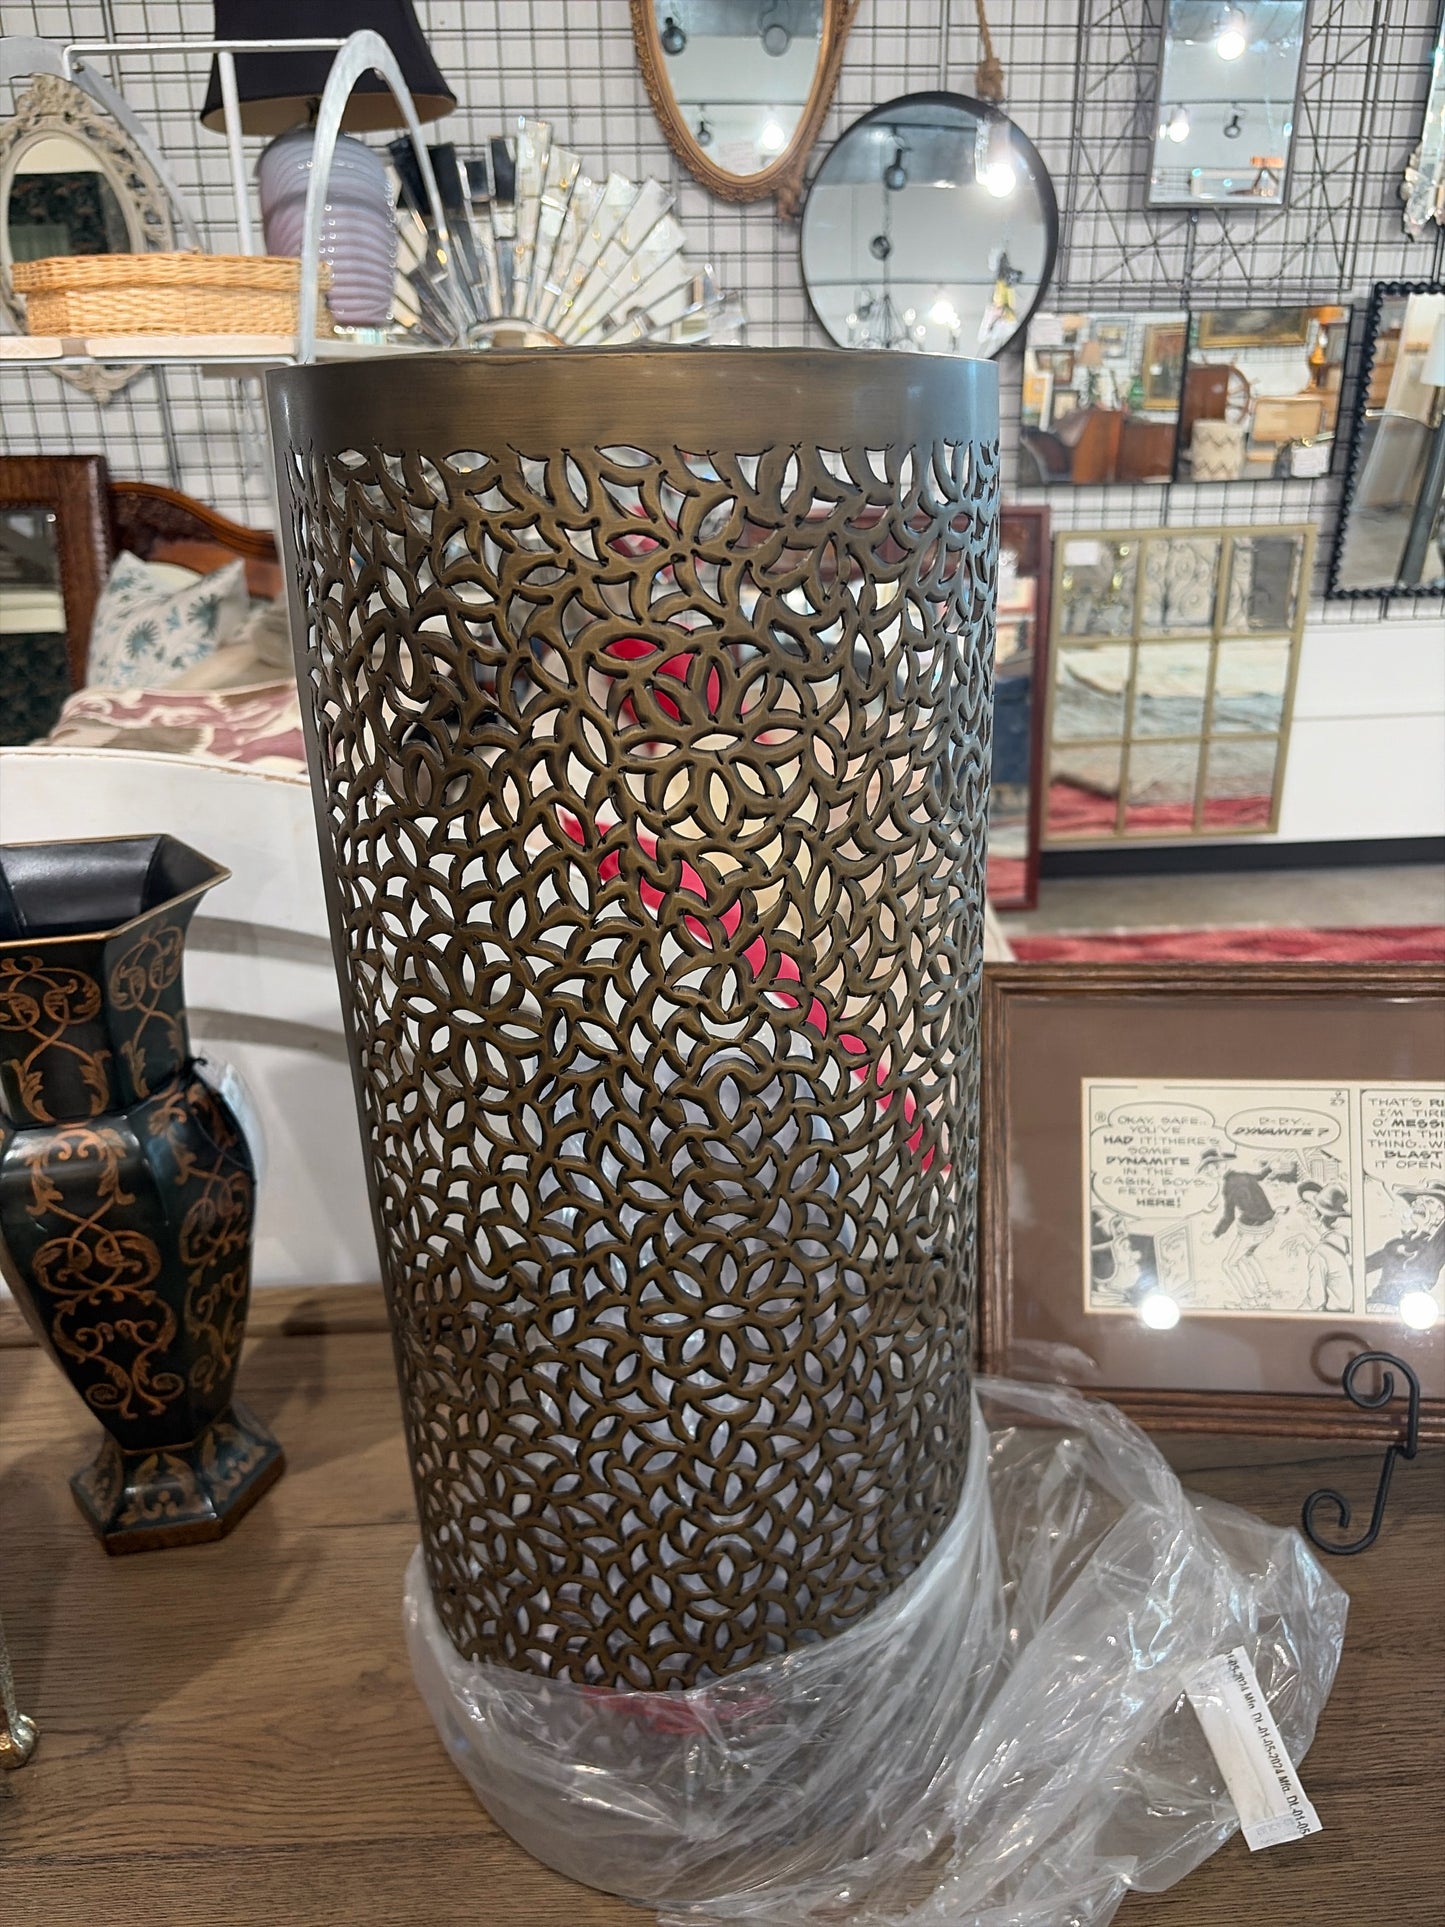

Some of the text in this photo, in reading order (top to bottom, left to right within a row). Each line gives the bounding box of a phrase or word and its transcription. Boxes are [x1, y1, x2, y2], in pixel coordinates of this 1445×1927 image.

[1368, 1097, 1422, 1107] THAT'S
[1378, 1108, 1403, 1117] I'M
[1391, 1118, 1445, 1128] MESSI
[1373, 1129, 1411, 1138] WITH
[1103, 1135, 1134, 1145] HAD
[1127, 1146, 1172, 1155] SOME
[1384, 1150, 1443, 1160] BLAST
[1106, 1156, 1190, 1166] DYNAMITE
[1375, 1160, 1442, 1169] IT OPEN
[1123, 1167, 1174, 1176] IN THE
[1118, 1186, 1189, 1196] FETCH IT
[1136, 1197, 1182, 1208] HERE!
